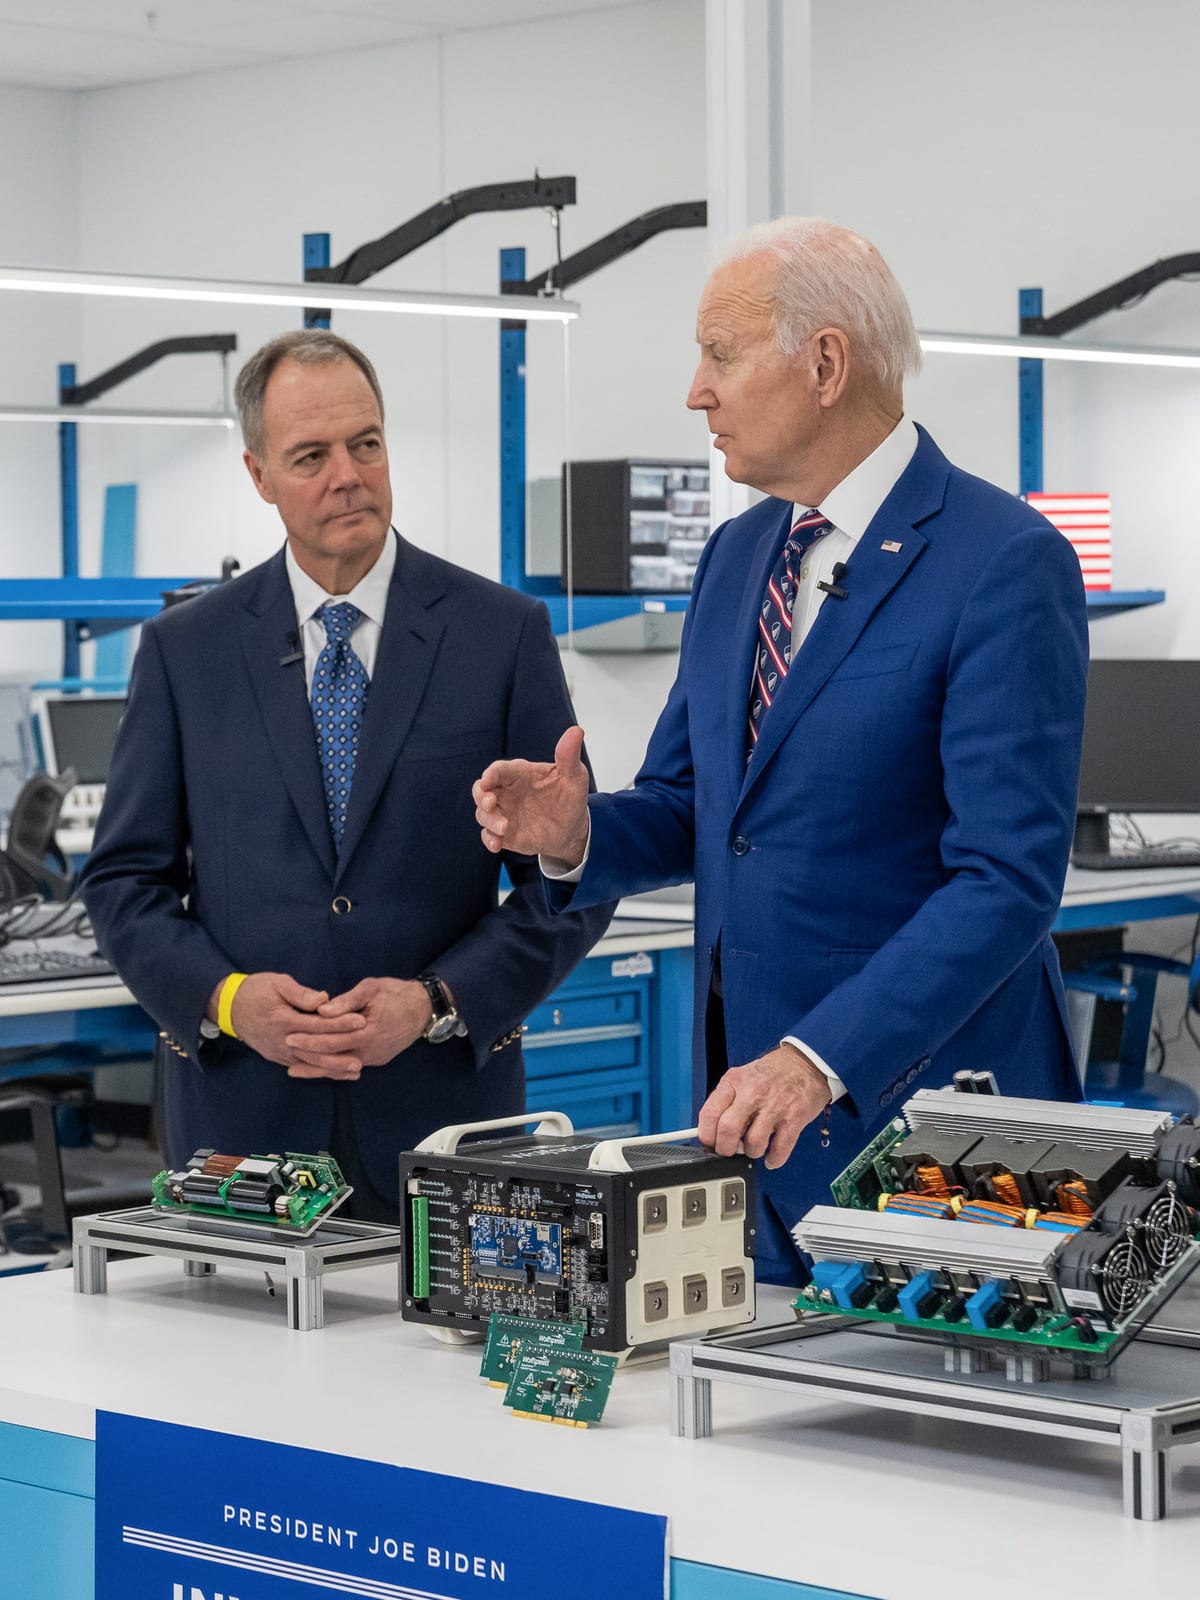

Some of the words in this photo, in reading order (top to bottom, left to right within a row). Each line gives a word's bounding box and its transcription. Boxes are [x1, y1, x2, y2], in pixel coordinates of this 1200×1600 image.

[223, 1504, 358, 1550] PRESIDENT
[368, 1536, 415, 1563] JOE
[427, 1547, 505, 1582] BIDEN
